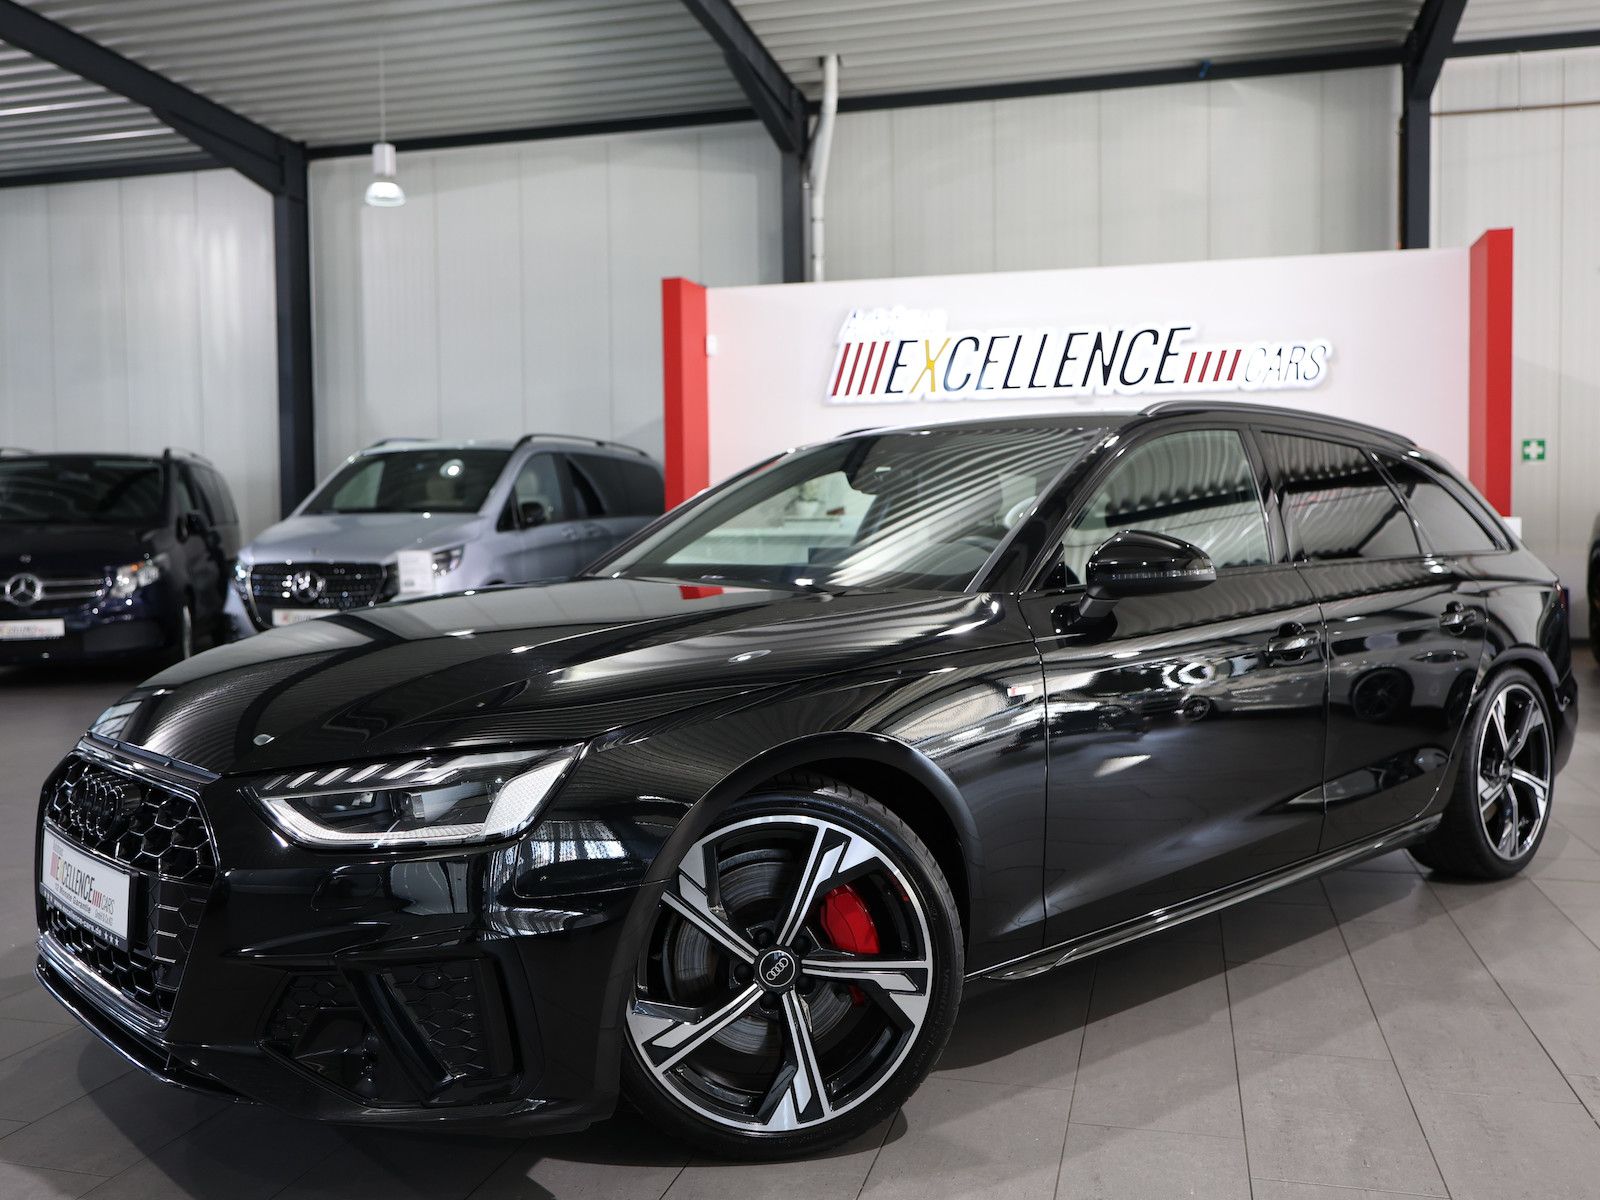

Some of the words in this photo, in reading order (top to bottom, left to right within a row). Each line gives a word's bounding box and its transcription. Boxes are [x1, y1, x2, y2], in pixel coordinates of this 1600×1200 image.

[885, 326, 1191, 395] EXCELLENCE
[1244, 345, 1327, 383] CARS
[55, 856, 95, 903] EXCELLENCE
